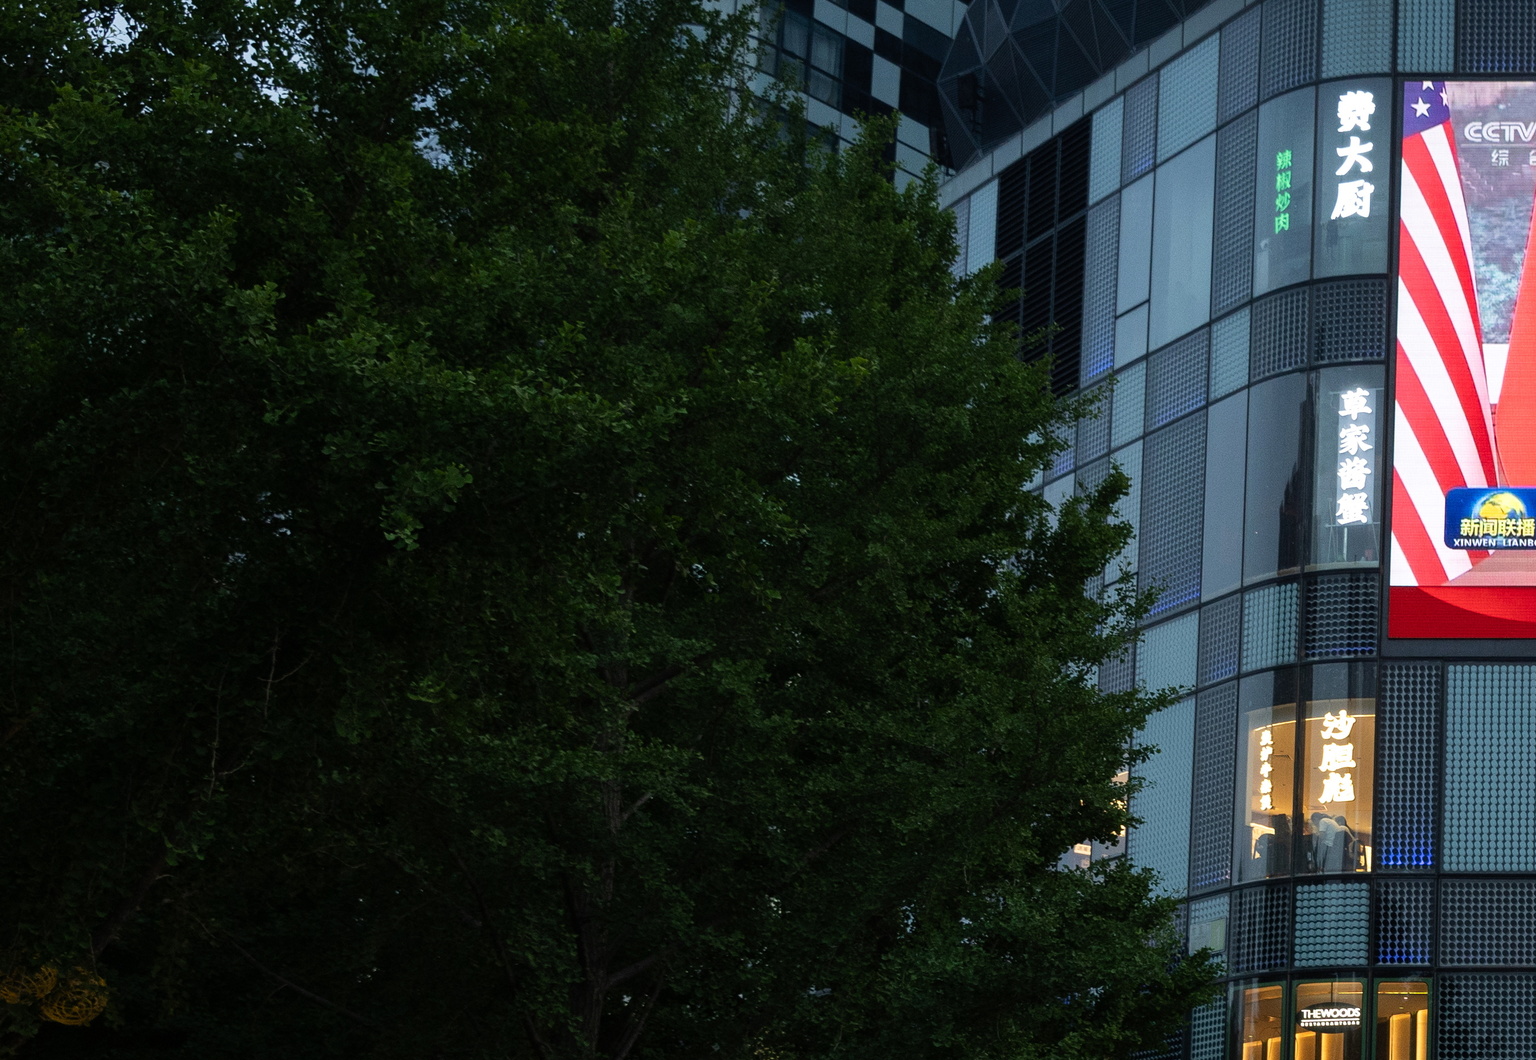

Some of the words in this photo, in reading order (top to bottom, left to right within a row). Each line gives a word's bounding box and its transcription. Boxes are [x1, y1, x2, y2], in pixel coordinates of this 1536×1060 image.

[1331, 90, 1376, 220] 费大厨
[1274, 149, 1292, 234] 辣椒炒肉
[1453, 538, 1497, 547] XINWEN
[1460, 518, 1536, 537] 新闻联播
